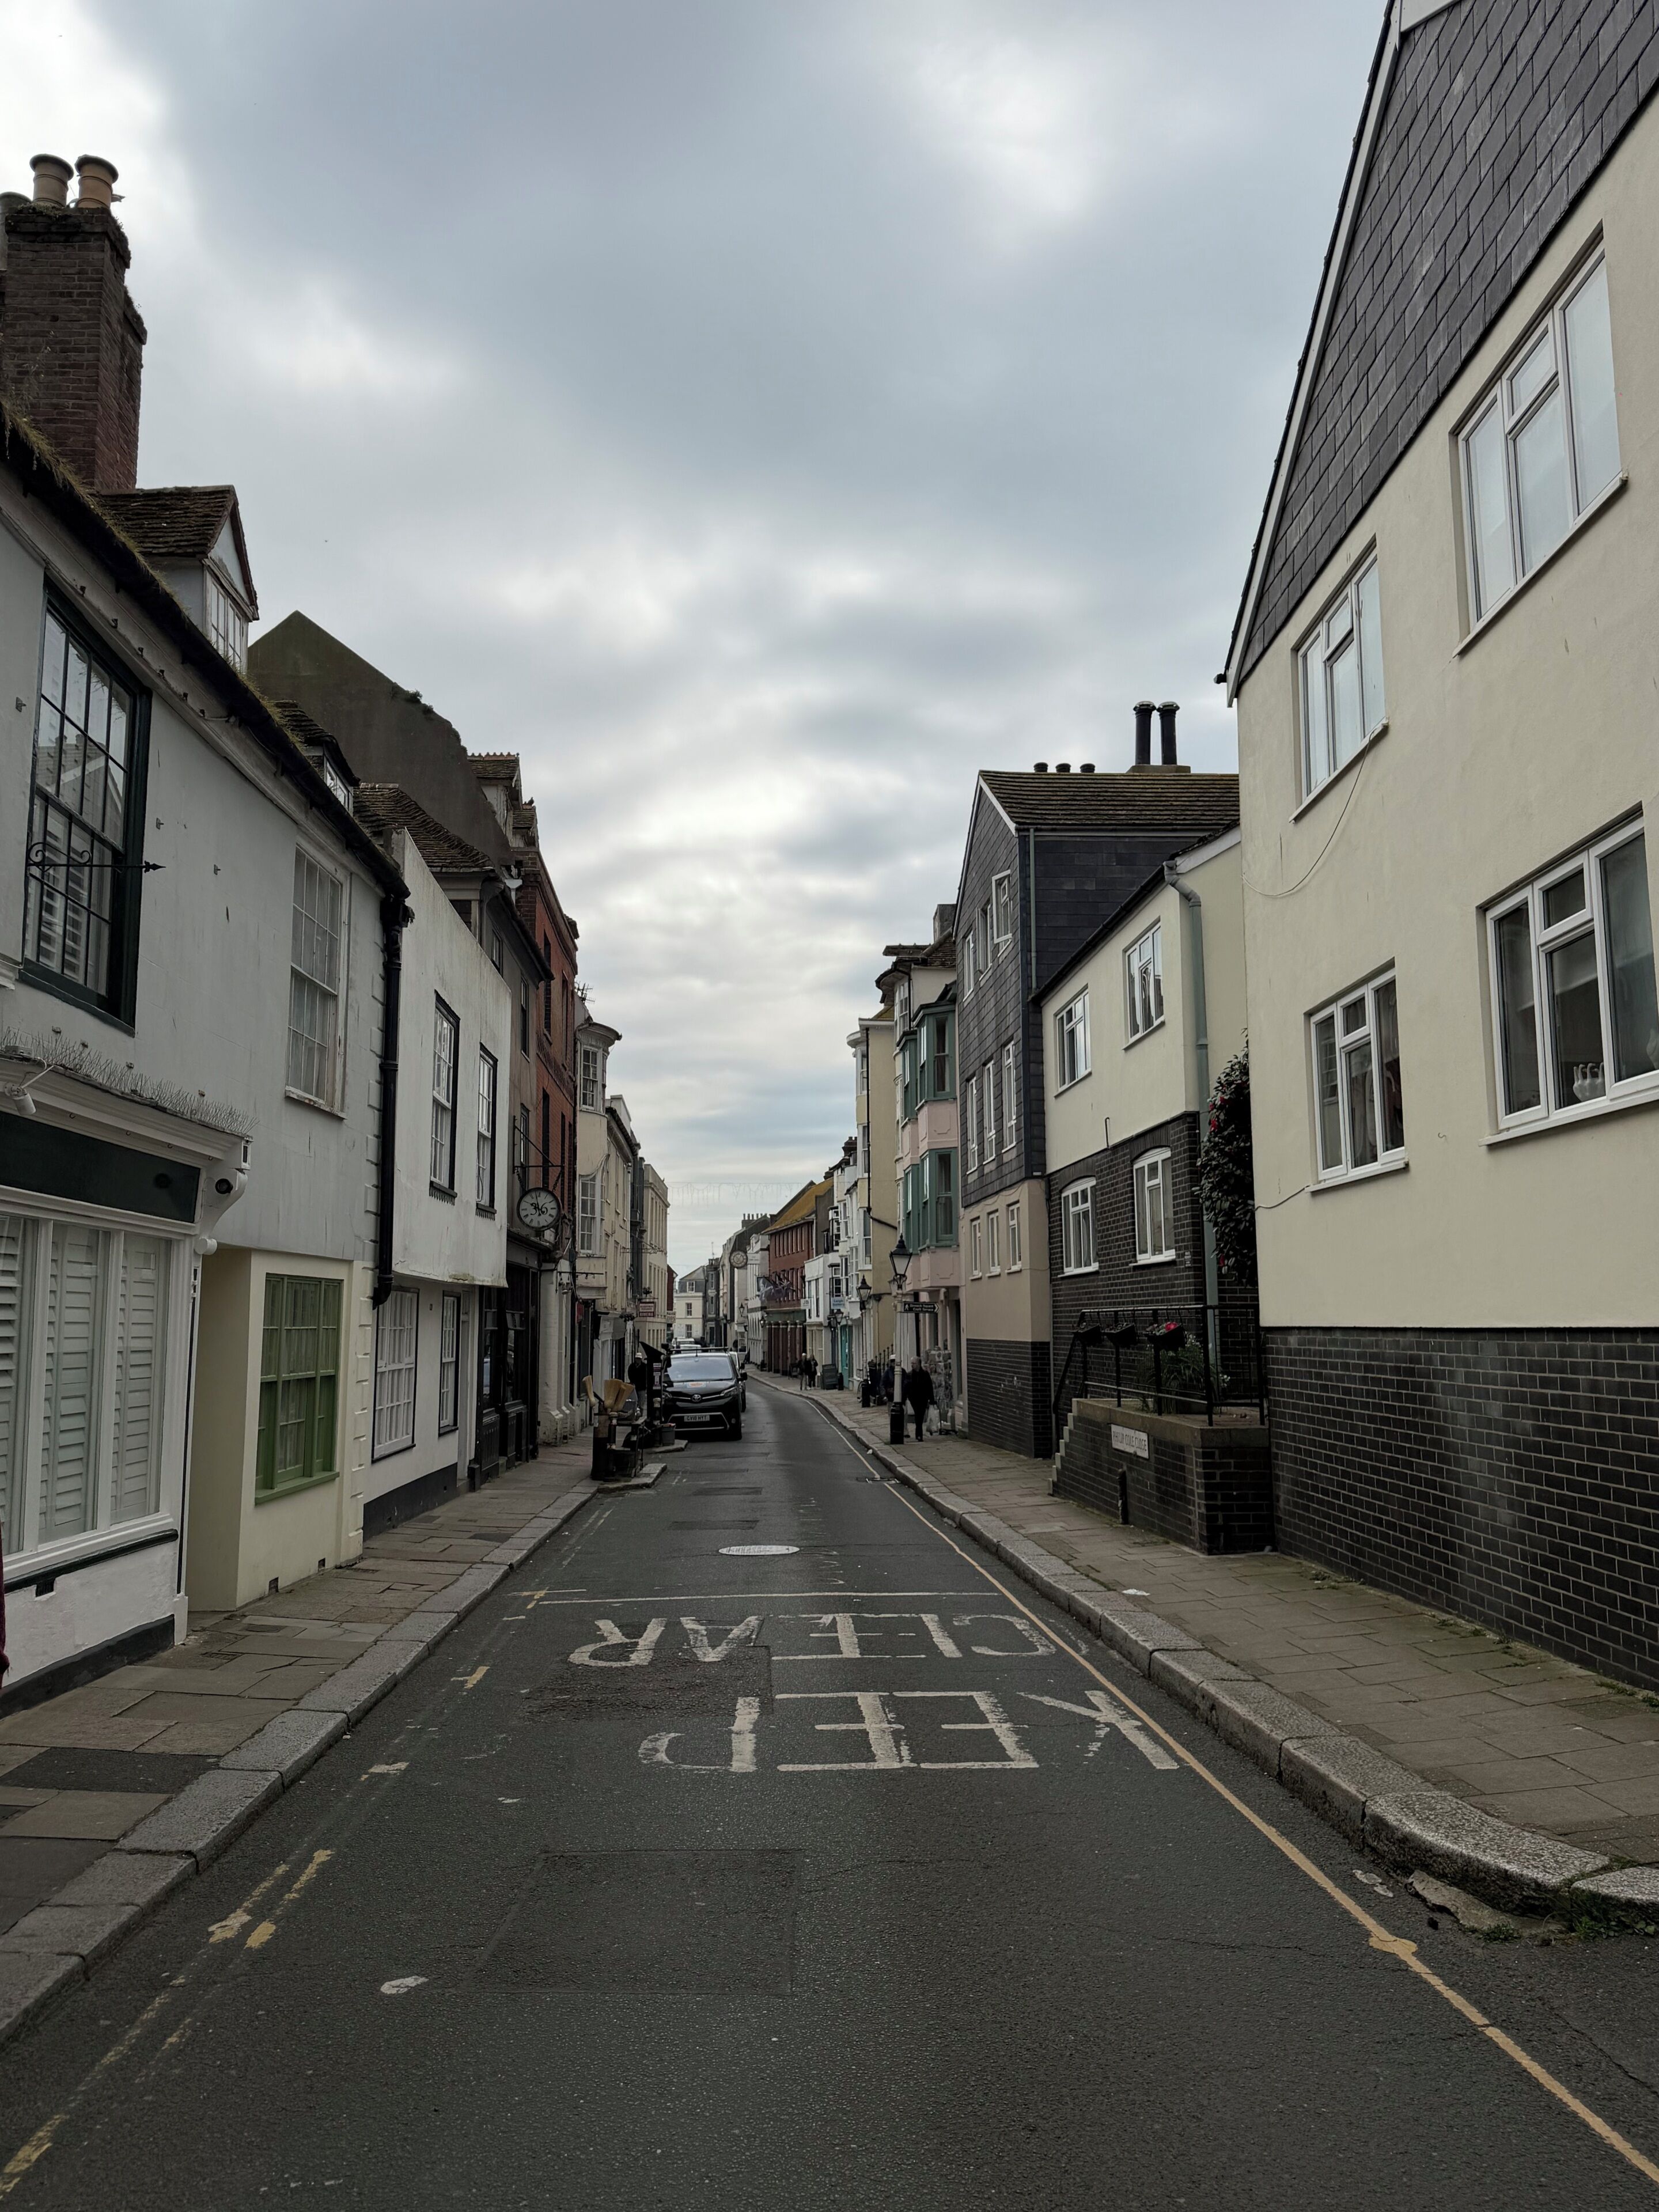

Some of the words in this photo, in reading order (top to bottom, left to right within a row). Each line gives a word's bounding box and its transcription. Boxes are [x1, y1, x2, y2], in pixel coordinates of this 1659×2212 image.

[1135, 1436, 1147, 1452] CLOSE
[567, 1613, 1056, 1667] CLEAR
[638, 1690, 1180, 1772] KEEP
